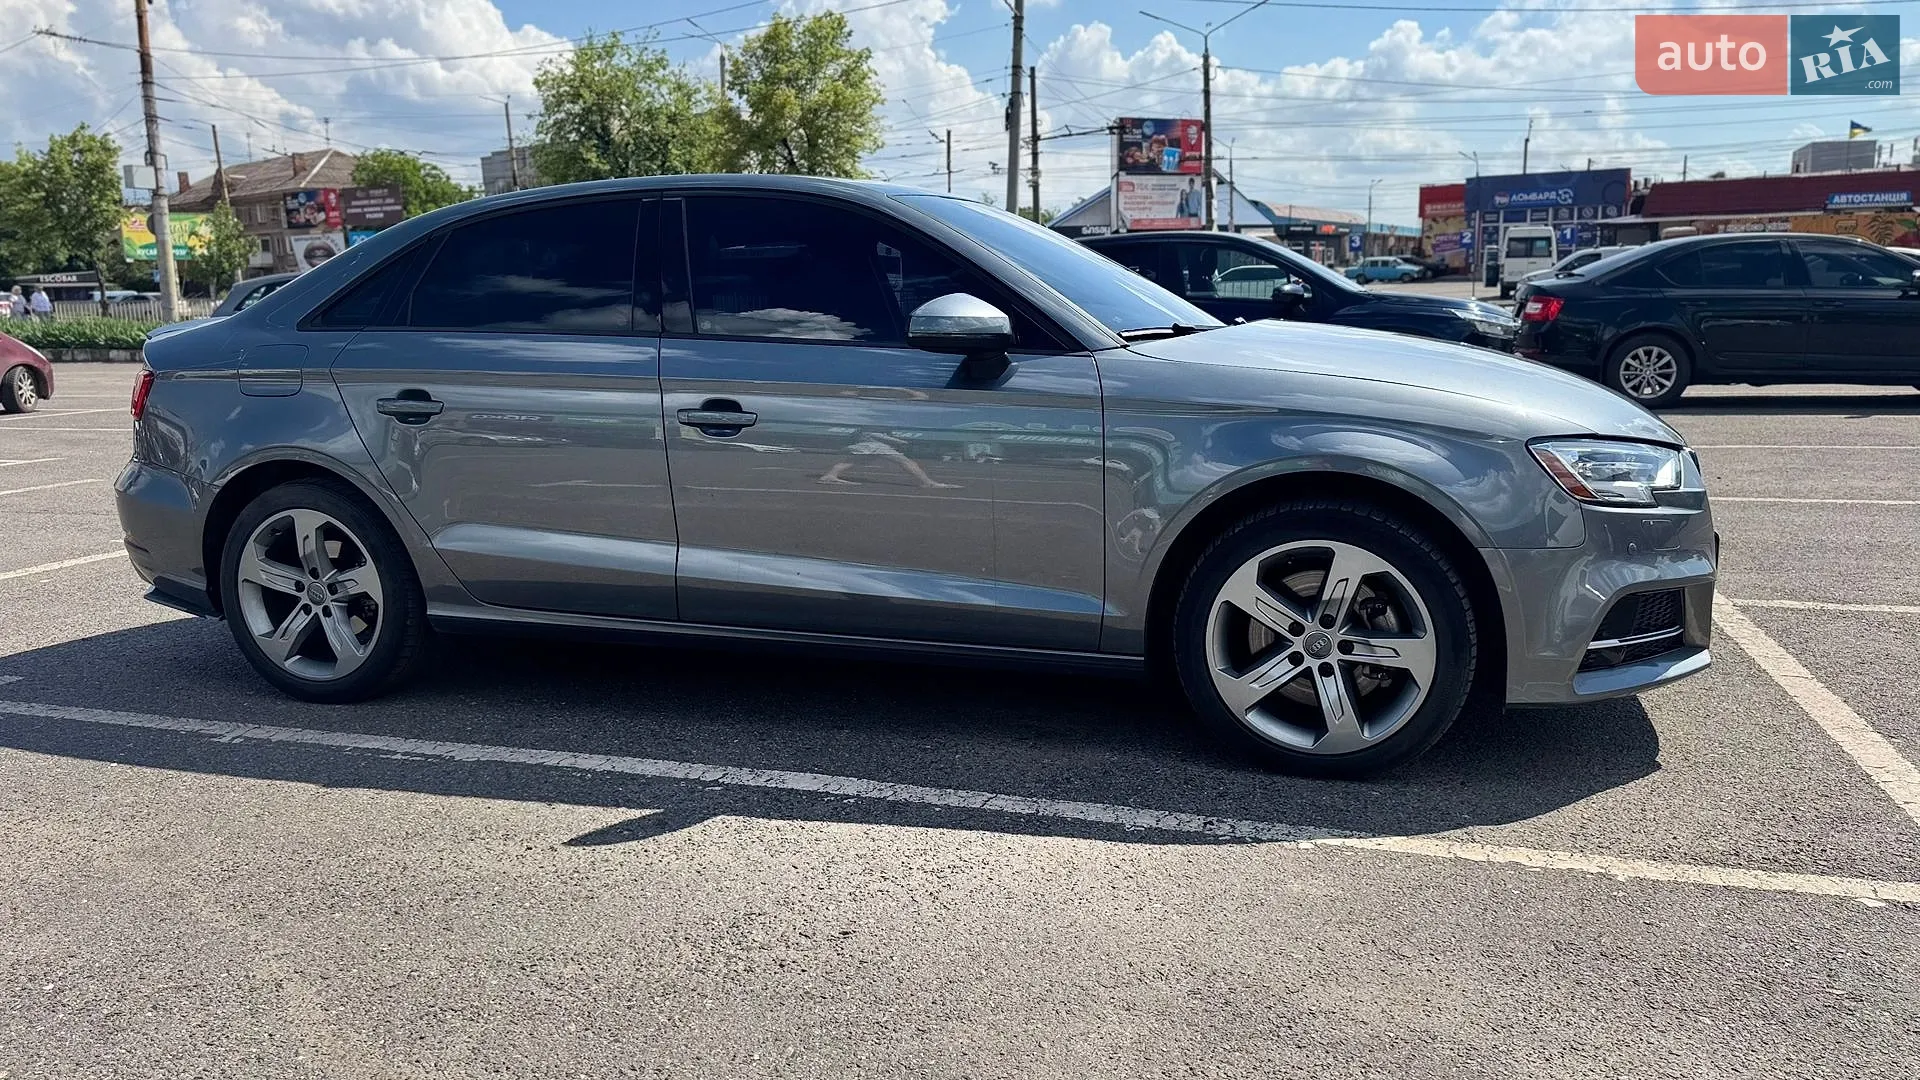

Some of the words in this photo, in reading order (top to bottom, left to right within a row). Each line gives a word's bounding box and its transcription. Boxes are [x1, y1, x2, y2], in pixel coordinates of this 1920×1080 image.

[1510, 191, 1557, 202] ЛОМБАРД
[1832, 192, 1908, 204] АВТОСТАНЦІЯ
[1462, 231, 1472, 243] 2
[1563, 227, 1572, 239] 1
[1351, 236, 1361, 247] 3
